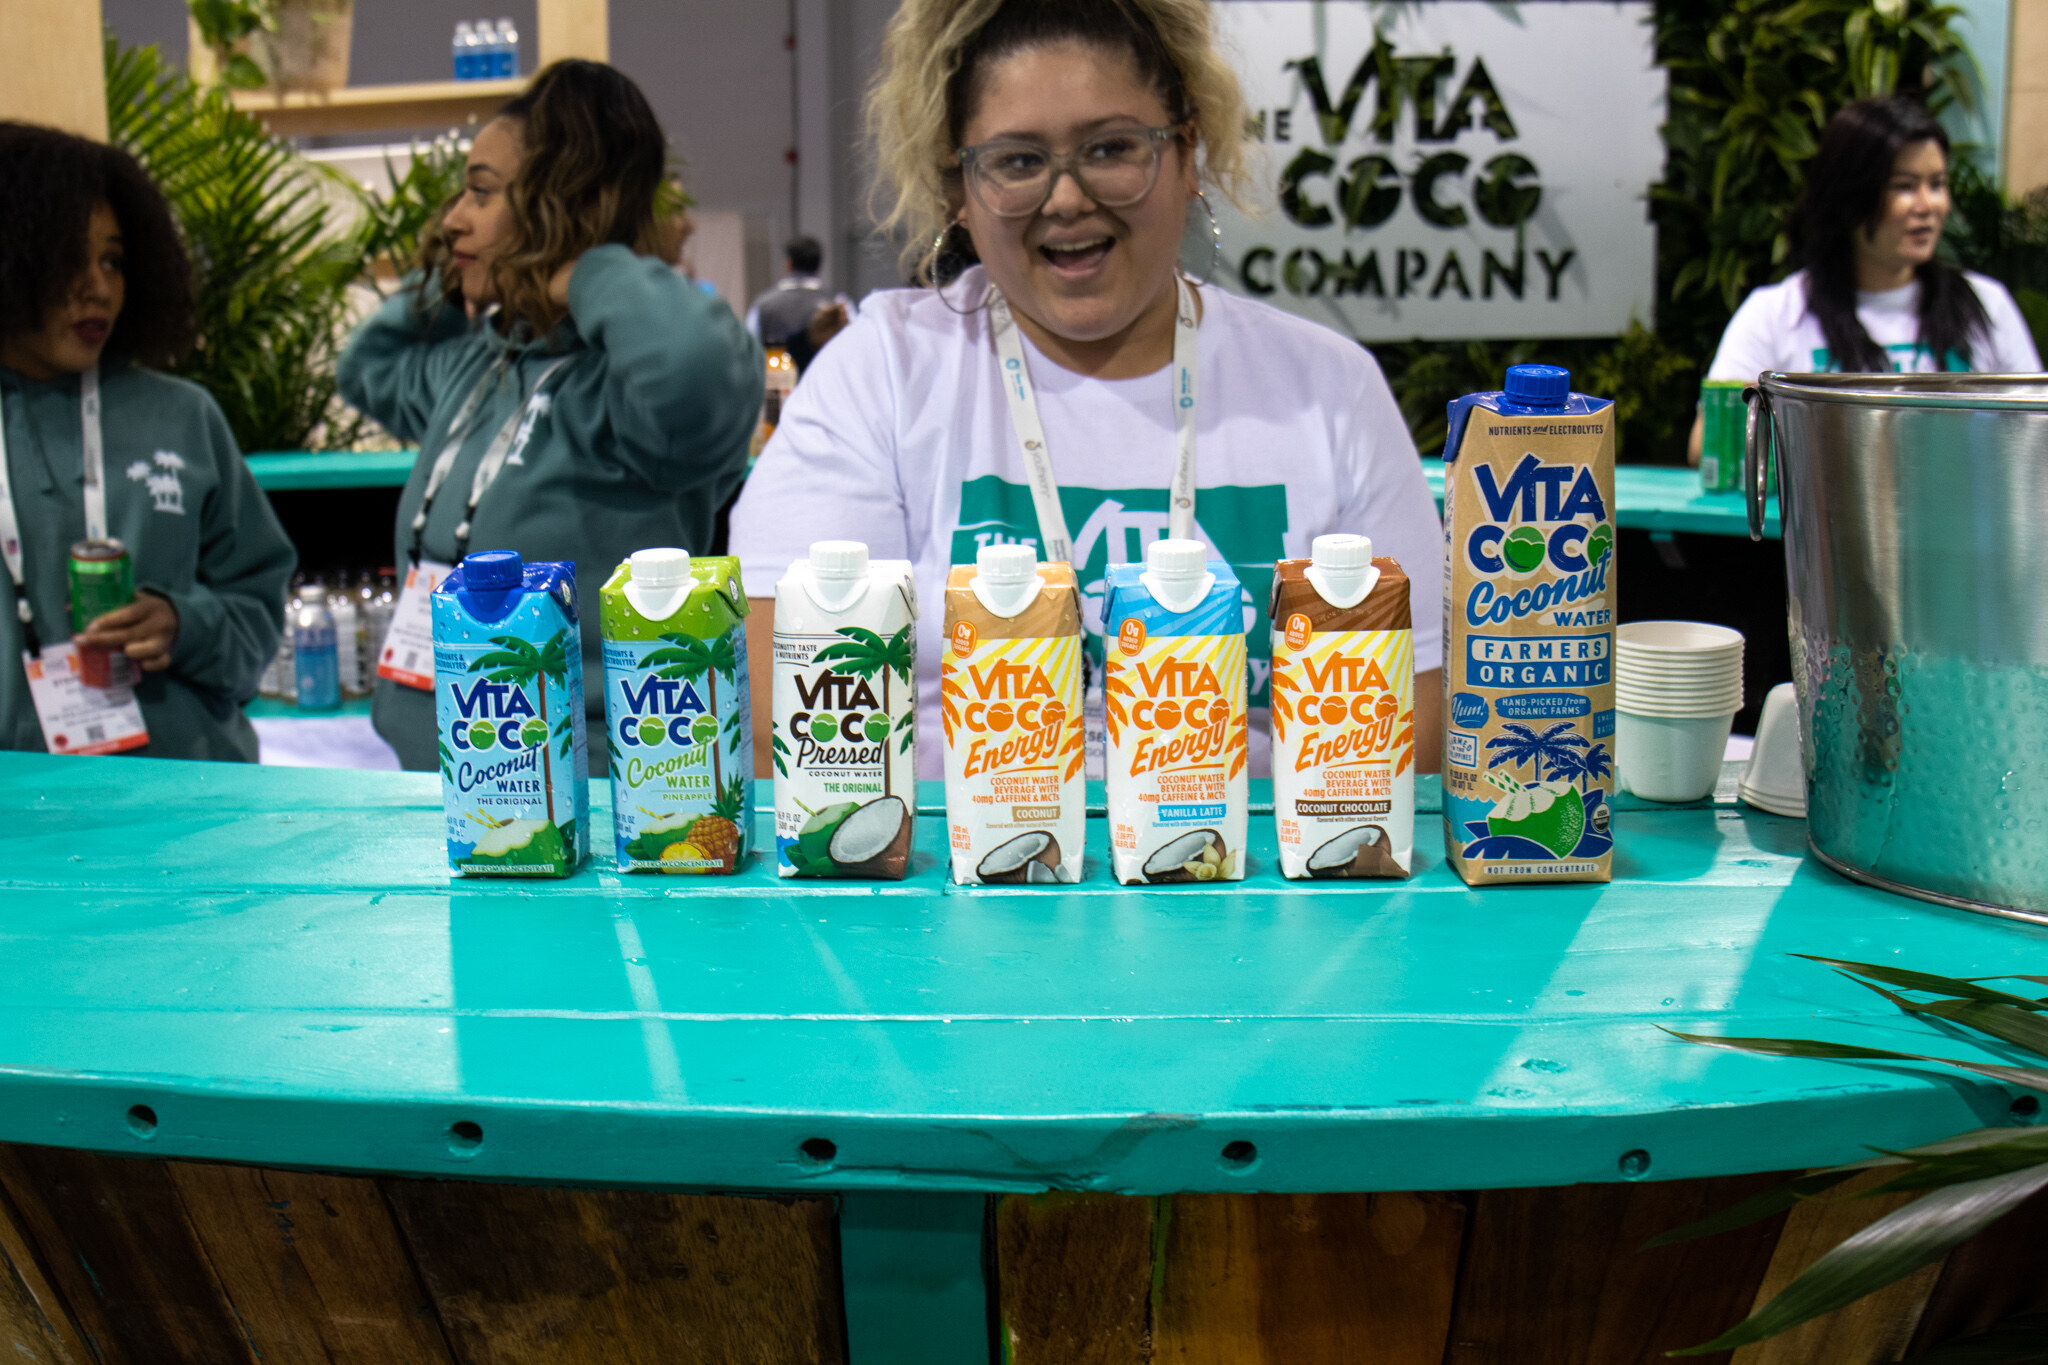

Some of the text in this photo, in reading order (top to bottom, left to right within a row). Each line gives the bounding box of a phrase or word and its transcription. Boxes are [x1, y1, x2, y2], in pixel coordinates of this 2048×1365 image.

[1296, 38, 1518, 143] VITA
[1242, 110, 1291, 142] HE
[1281, 149, 1541, 229] COCO
[1241, 247, 1576, 299] COMPANY
[1489, 425, 1603, 436] NUTRIENTS and ELECTROLYTES
[1474, 454, 1606, 522] VITA
[1469, 524, 1613, 573] COCO
[1466, 546, 1612, 626] Coconut
[1293, 616, 1305, 632] 0g
[1553, 609, 1610, 627] WATER
[958, 624, 971, 640] 0g
[1126, 622, 1139, 637] 0g
[779, 652, 809, 660] NUTRIENTS
[799, 644, 817, 652] TASTE
[1485, 641, 1602, 660] FARMERS
[968, 658, 1056, 700] VITA
[1136, 656, 1222, 698] VITA
[1302, 651, 1390, 693] VITA
[1480, 663, 1603, 683] ORGANIC
[450, 678, 537, 718] VITA
[620, 674, 708, 715] VITA
[794, 669, 880, 710] VITA
[1297, 694, 1398, 726] COCO
[1502, 697, 1587, 706] HAND-PICKED from
[965, 701, 1066, 732] COCO
[1132, 698, 1230, 730] COCO
[1508, 707, 1581, 716] ORGANIC FARMS
[451, 720, 548, 750] COCO
[620, 715, 718, 746] COCO
[790, 712, 890, 743] COCO
[797, 736, 885, 767] Pressed
[964, 720, 1061, 779] Energy
[1130, 717, 1227, 778] Energy
[1295, 713, 1394, 773] Energy
[459, 742, 542, 792] Coconut
[627, 738, 713, 788] Coconut
[666, 775, 710, 788] WATER
[990, 776, 1058, 785] COCONUT WATER
[1157, 774, 1225, 784] COCONUT WATER
[1322, 770, 1391, 779] COCONUT WATER
[1326, 778, 1391, 788] BEVERAGE WITH
[496, 780, 540, 792] WATER
[824, 783, 882, 793] THE ORIGINAL
[994, 785, 1035, 794] BEVERAGE
[1161, 783, 1225, 792] BEVERAGE WITH
[1303, 787, 1391, 798] 40mg CAFFEINE & MCTs
[973, 795, 993, 805] 40mg
[995, 794, 1030, 803] CAFFEINE
[1041, 794, 1060, 802] MCTs
[1138, 793, 1160, 803] 40mg
[1162, 793, 1198, 802] CAFFEINE
[1207, 792, 1226, 800] MCTs
[1017, 808, 1057, 818] COCONUT
[1162, 807, 1223, 818] VANILLA LATTE
[1297, 803, 1388, 813] COCONUT CHOCOLATE
[500, 864, 553, 873] CONCENTRATE
[668, 859, 722, 867] CONCENTRATE
[1487, 864, 1595, 874] NOT FROM CONCENTRATE
